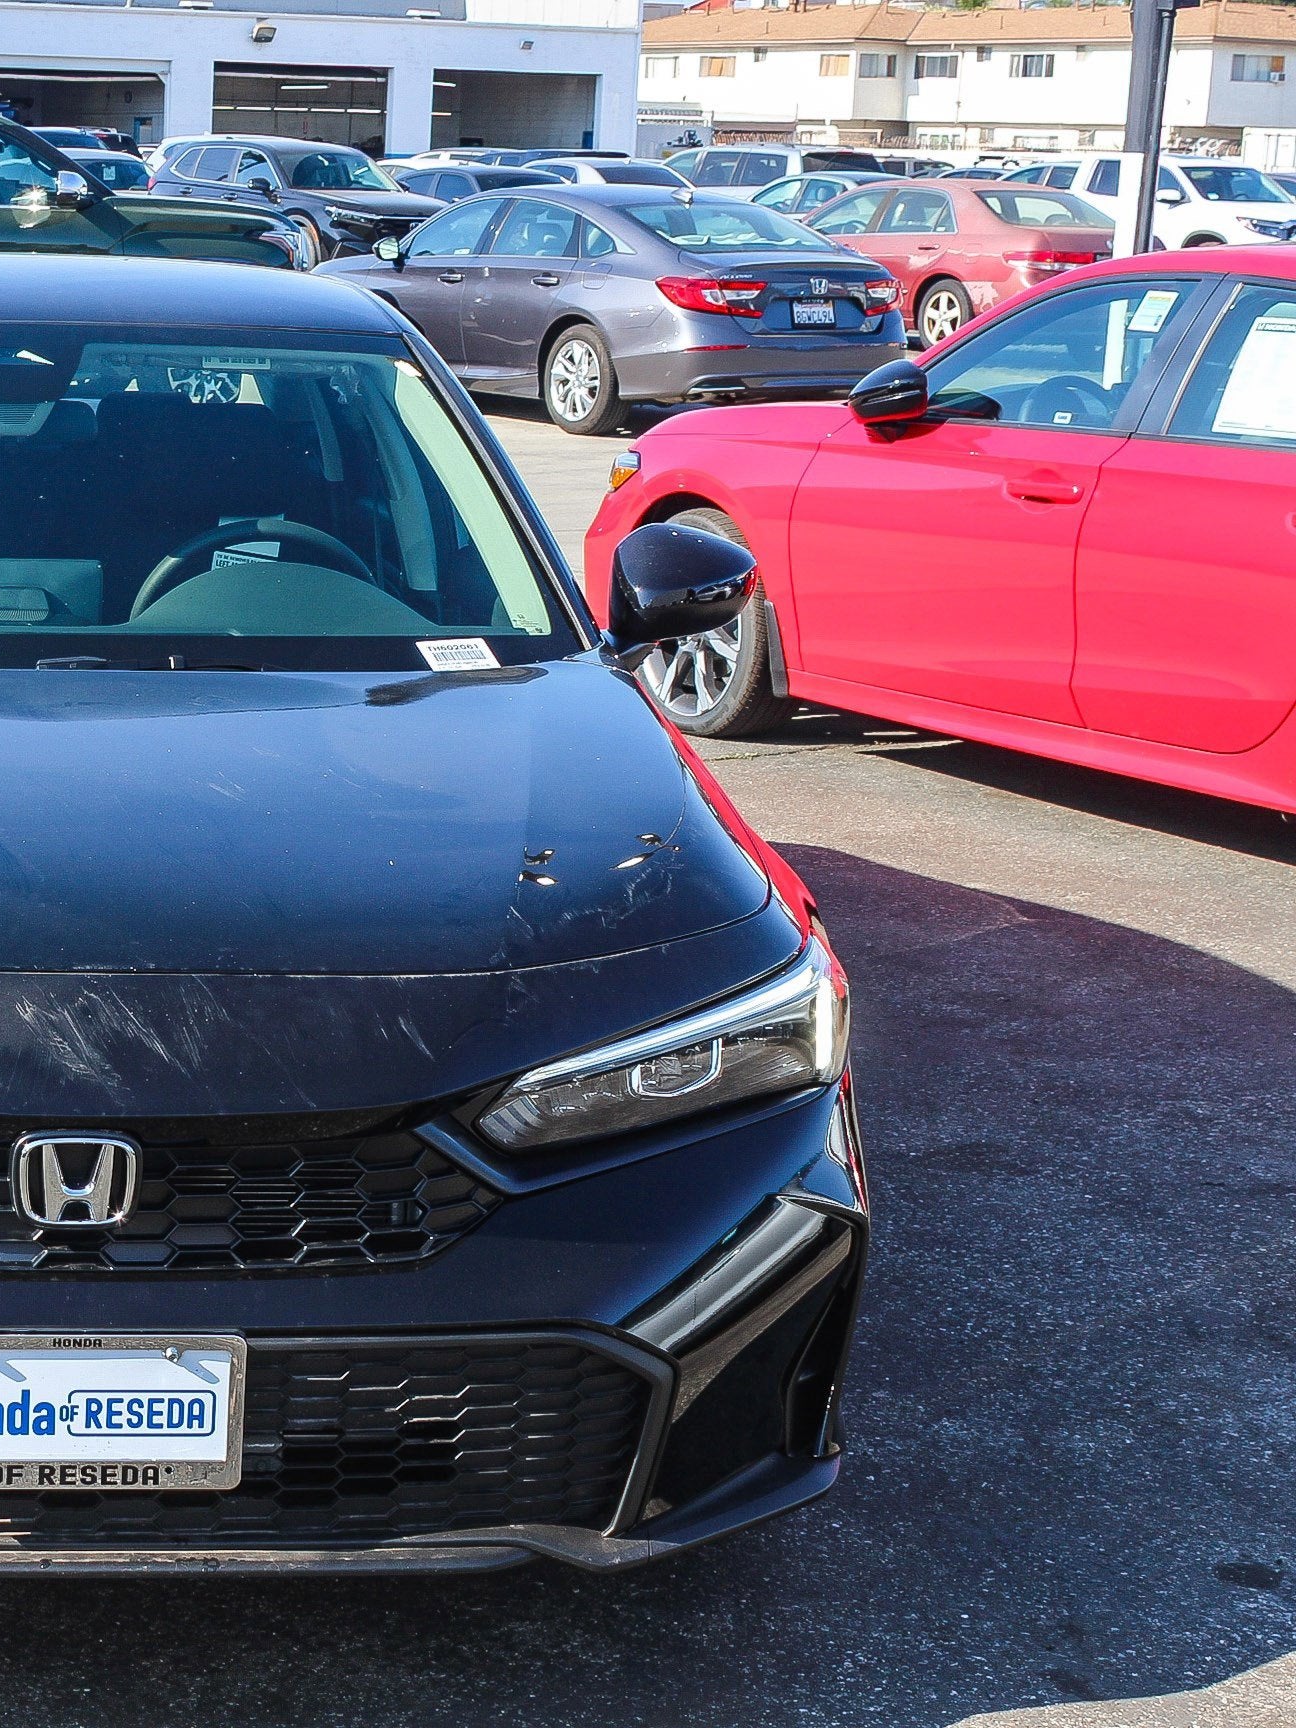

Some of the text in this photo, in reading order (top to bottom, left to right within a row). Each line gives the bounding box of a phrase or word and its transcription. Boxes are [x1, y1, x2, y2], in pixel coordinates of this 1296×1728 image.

[52, 1337, 103, 1348] HONDA
[59, 1404, 79, 1422] OF
[85, 1397, 205, 1429] RESEDA
[38, 1464, 160, 1486] RESEDA
